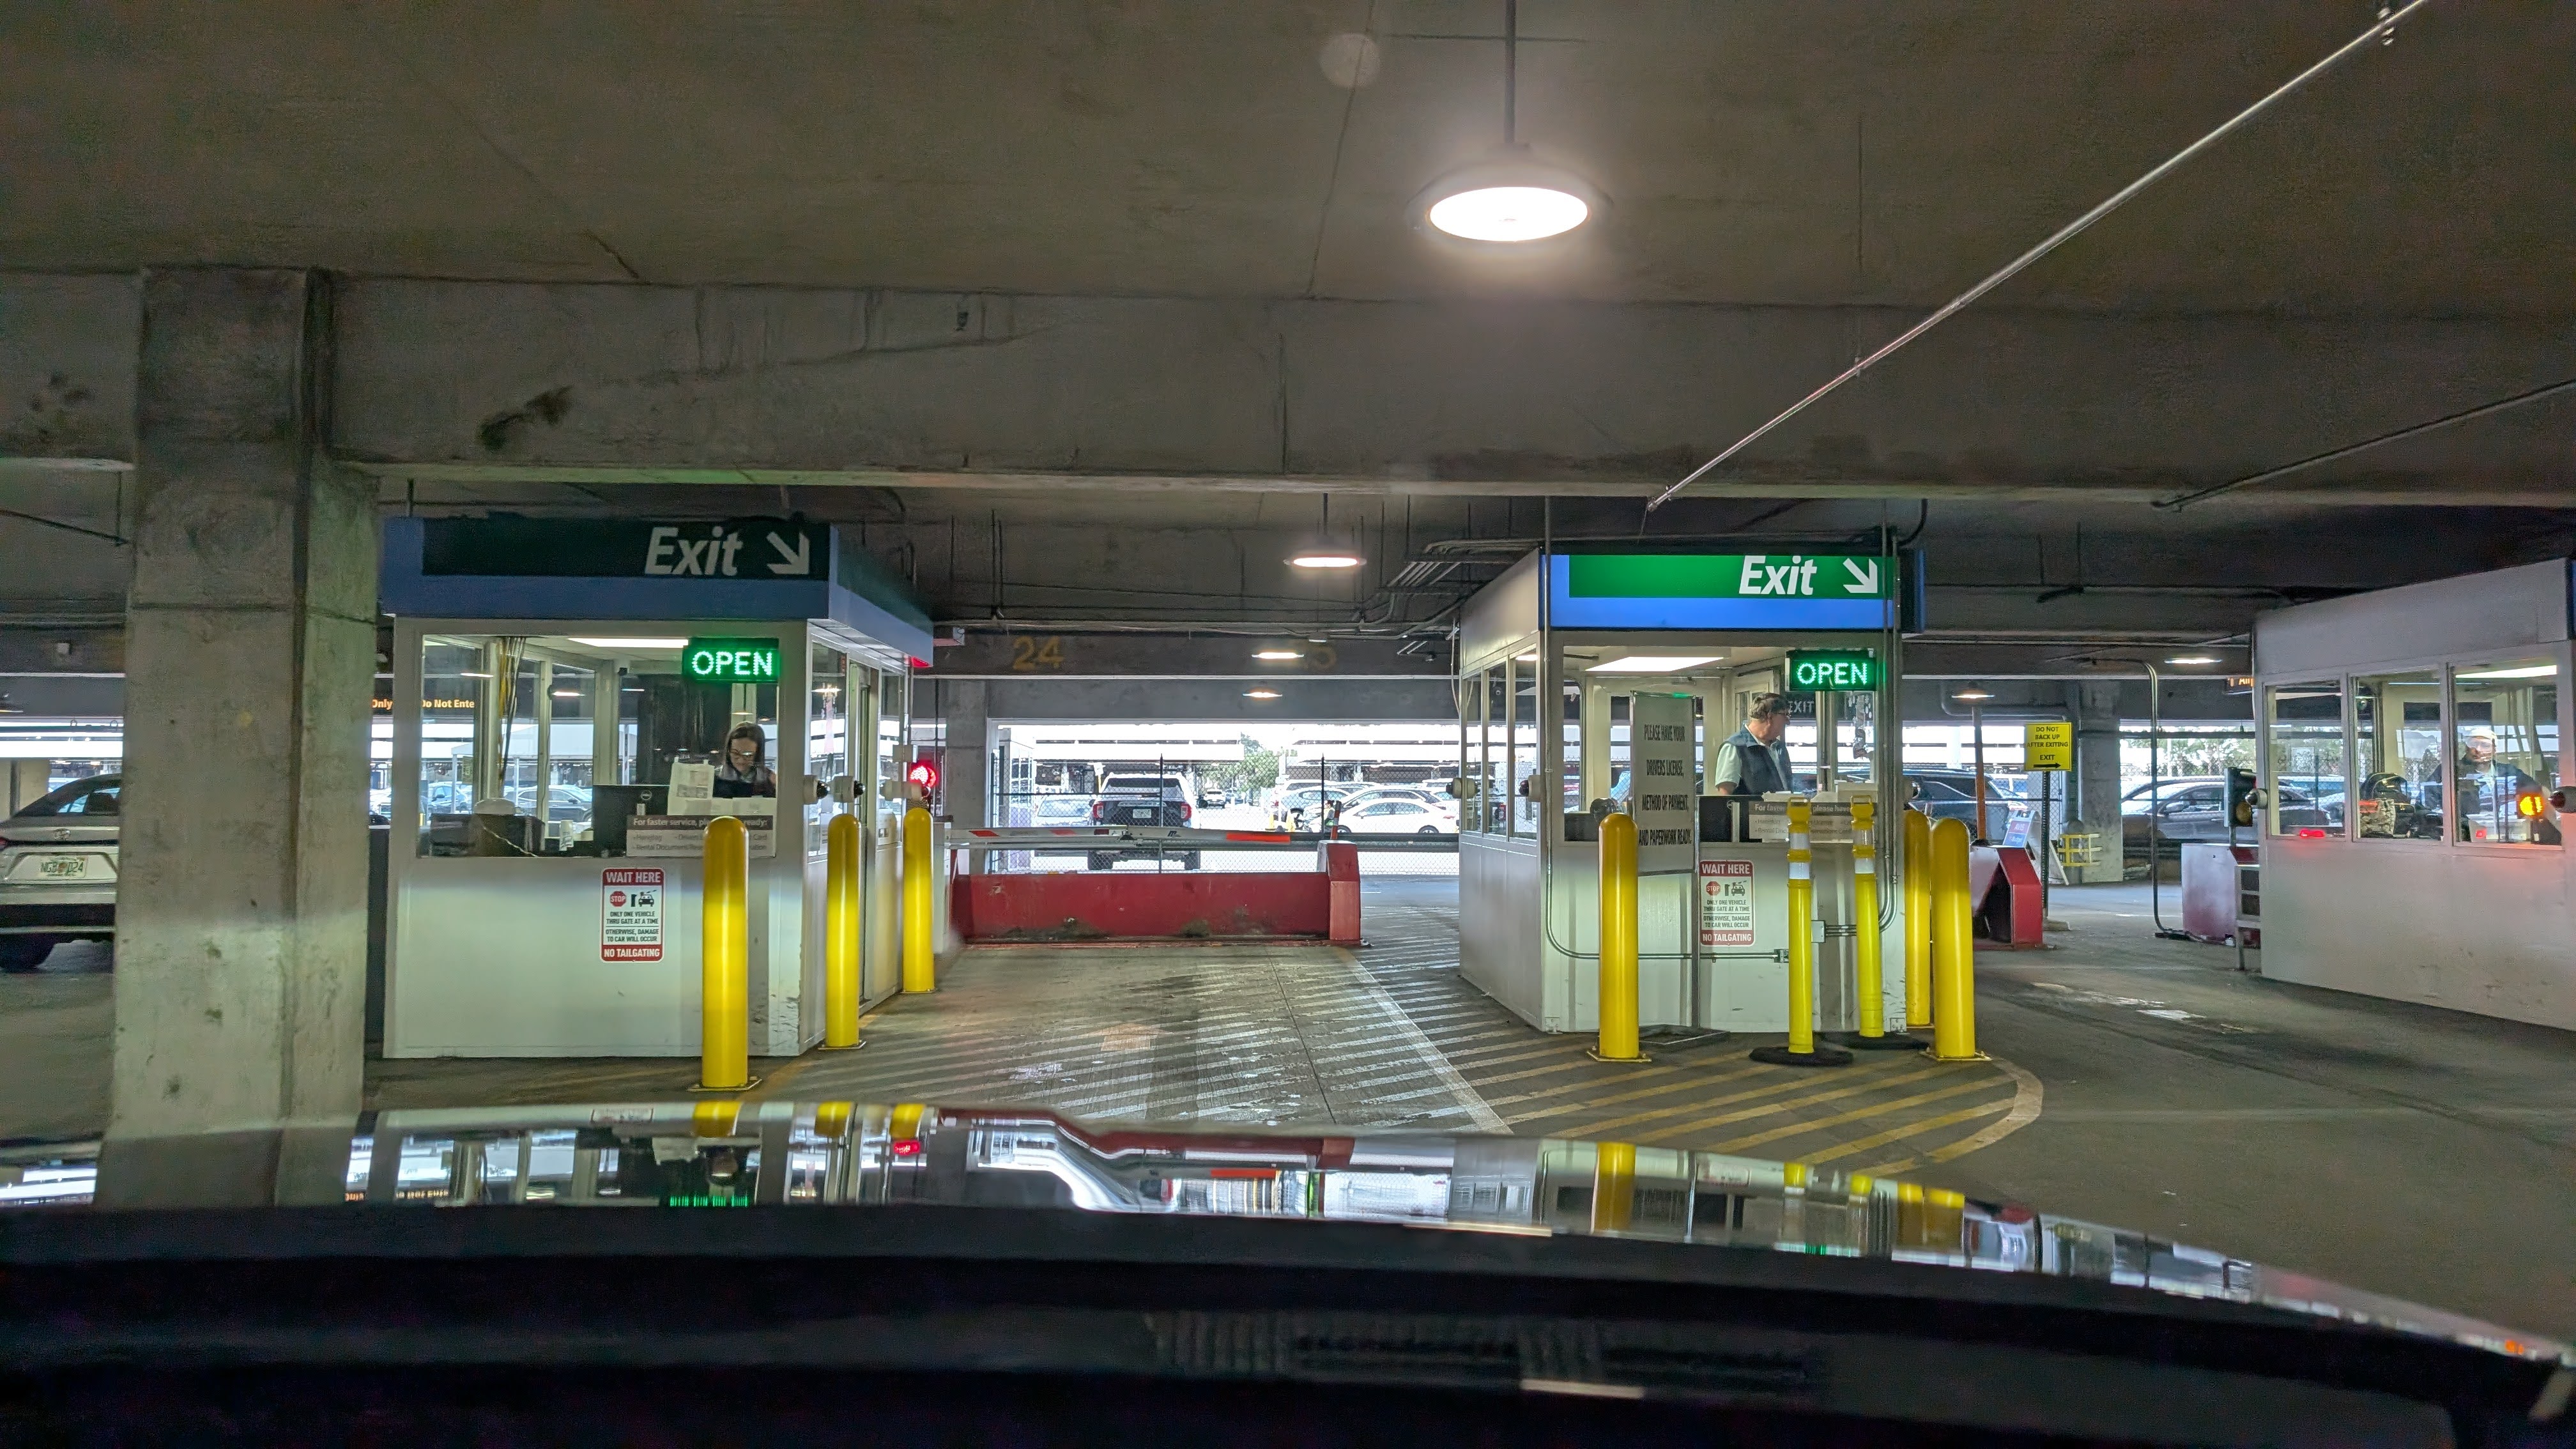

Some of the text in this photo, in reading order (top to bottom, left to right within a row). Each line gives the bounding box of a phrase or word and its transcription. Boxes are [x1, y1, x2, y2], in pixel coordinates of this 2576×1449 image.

[644, 526, 744, 576] Exit
[1739, 555, 1818, 595] Exit
[1013, 636, 1064, 670] 24
[691, 650, 772, 676] OPEN
[1797, 662, 1868, 685] OPEN
[372, 698, 394, 710] Only
[434, 699, 452, 708] Not
[454, 699, 475, 708] Ente
[1644, 724, 1685, 742] PLEASE HAVE YOUR
[1646, 759, 1666, 776] DRIVERS
[1642, 794, 1661, 811] METHOD
[1662, 794, 1668, 811] OF
[1754, 803, 1765, 811] For
[1812, 804, 1833, 814] please
[1639, 829, 1648, 846] AND
[1650, 829, 1676, 846] PAPERWORK
[606, 871, 661, 883] WAIT HERE
[1701, 863, 1750, 874] WAIT HERE
[1703, 933, 1752, 942] NO TAILGATING
[604, 948, 660, 957] NO TAILGATING
